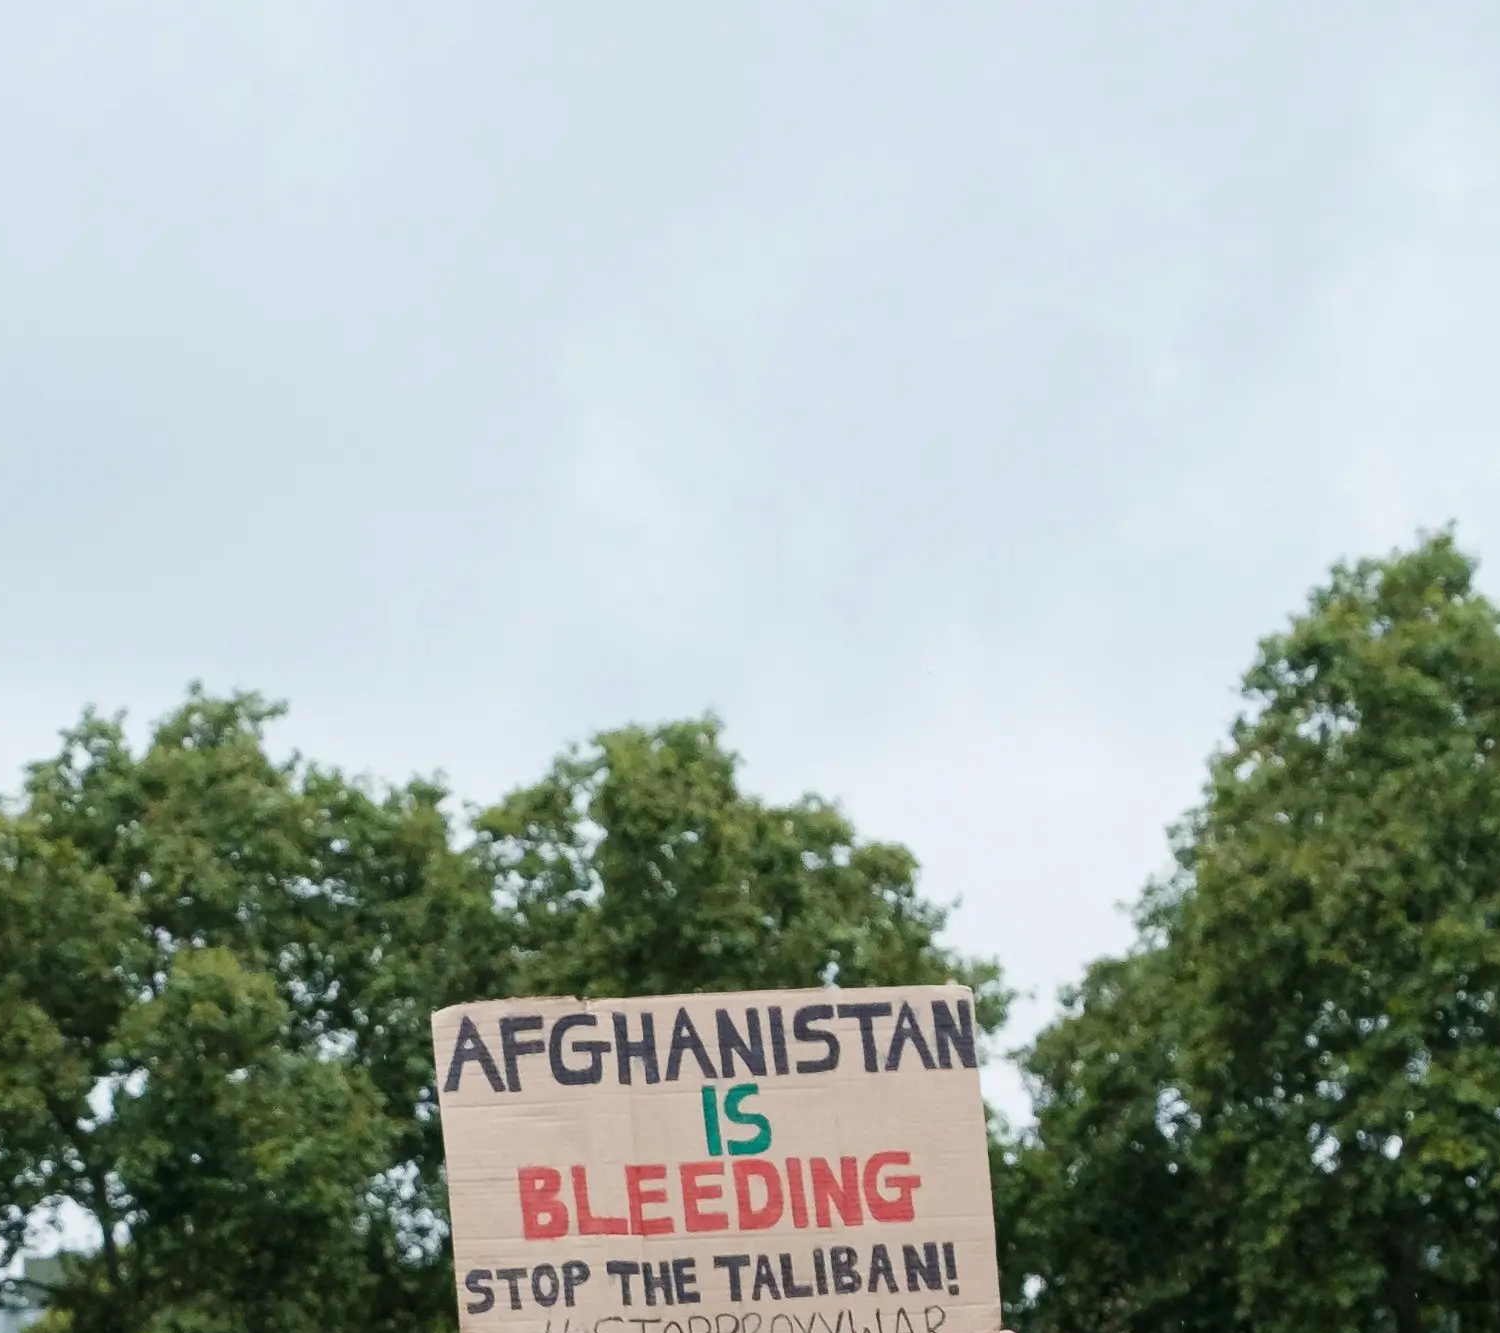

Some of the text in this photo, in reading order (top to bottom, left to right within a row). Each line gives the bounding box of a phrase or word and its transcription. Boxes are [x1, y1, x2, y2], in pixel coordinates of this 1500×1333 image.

[442, 999, 978, 1094] AFGHANISTAN
[700, 1082, 773, 1157] IS
[517, 1150, 922, 1241] BLEEDING
[463, 1241, 961, 1314] STOP THE TALIBAN!
